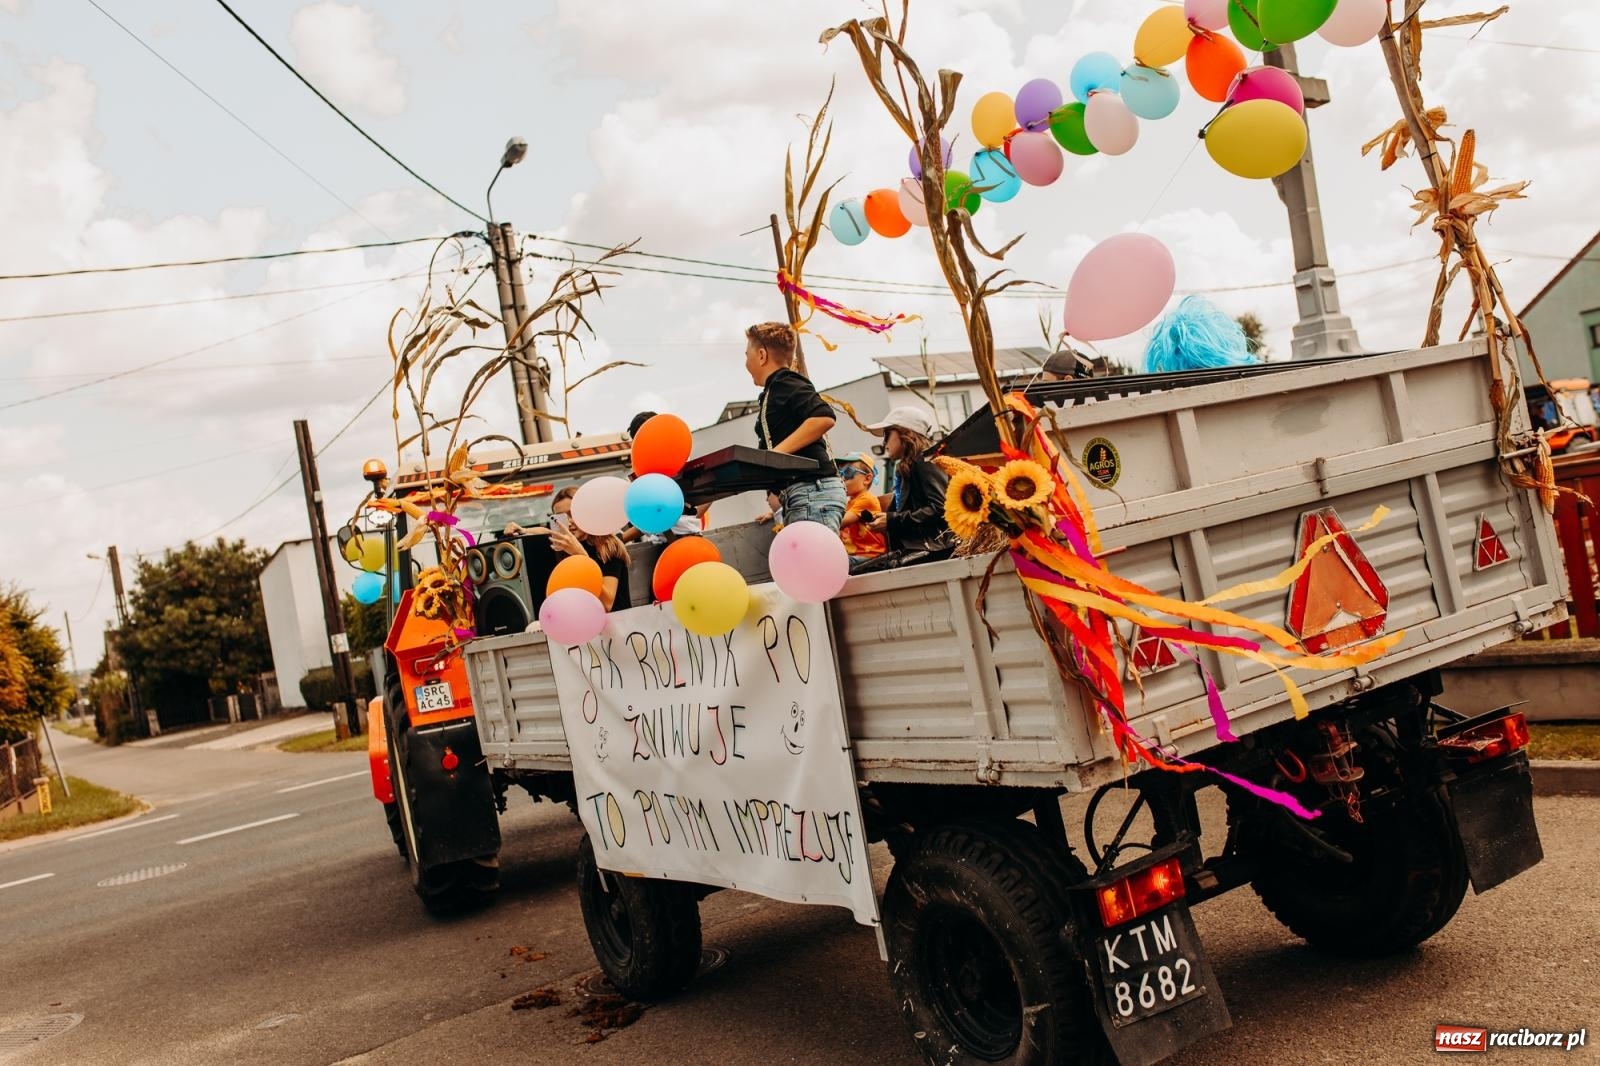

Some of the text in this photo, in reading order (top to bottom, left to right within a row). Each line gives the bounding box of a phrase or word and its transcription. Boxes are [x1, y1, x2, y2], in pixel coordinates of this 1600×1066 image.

[1090, 459, 1114, 471] AGROS
[423, 685, 445, 697] SRC
[568, 614, 811, 724] JAK ROLNIK PO
[586, 791, 626, 851] TO
[633, 789, 720, 851] POTYM
[1103, 914, 1178, 973] KTM
[1114, 958, 1196, 1017] 8682
